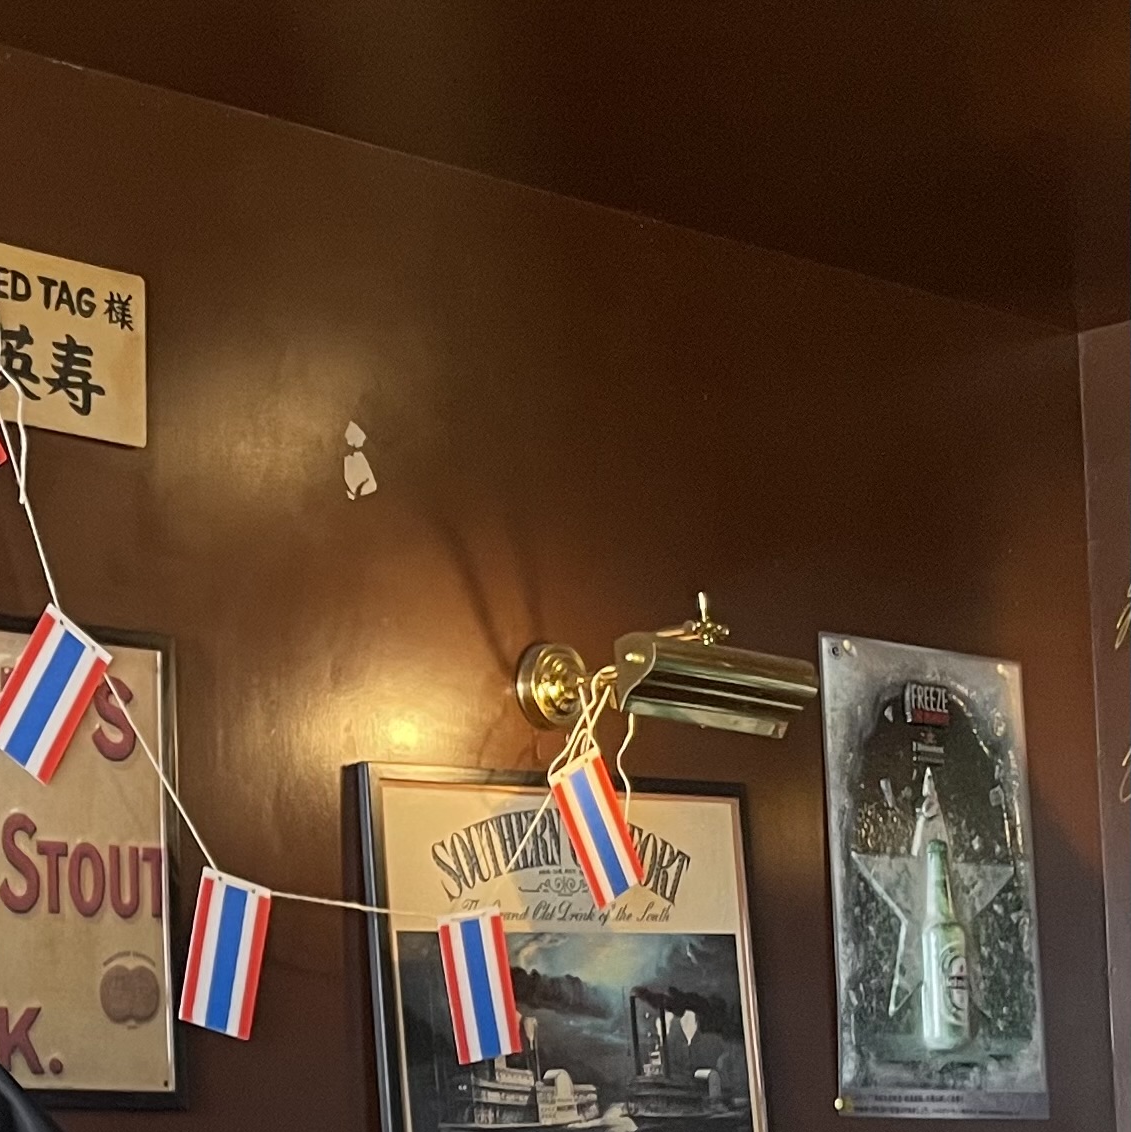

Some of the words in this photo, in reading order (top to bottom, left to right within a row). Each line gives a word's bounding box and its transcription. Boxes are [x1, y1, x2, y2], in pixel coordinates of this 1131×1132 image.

[37, 275, 97, 318] TAG
[103, 291, 134, 332] 様
[911, 683, 949, 714] FREEZE
